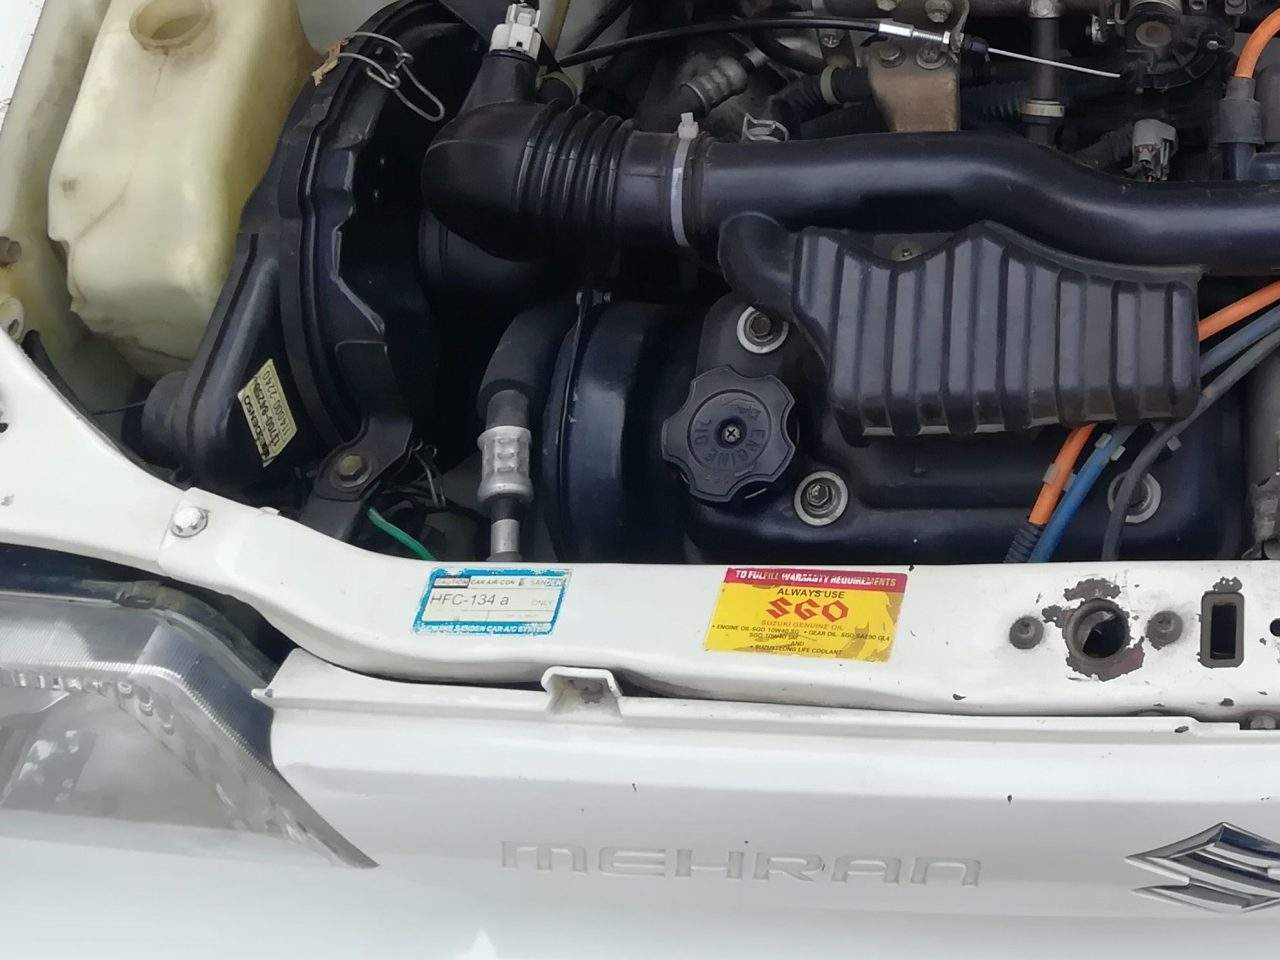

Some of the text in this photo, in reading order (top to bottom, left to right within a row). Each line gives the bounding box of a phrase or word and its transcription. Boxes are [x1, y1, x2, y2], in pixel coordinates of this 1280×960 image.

[830, 575, 897, 587] REQUIREMENTS
[777, 588, 845, 599] ALWAYS USE
[430, 594, 509, 606] HFC-134 a
[765, 597, 849, 622] SGO
[793, 622, 829, 630] GENUINE
